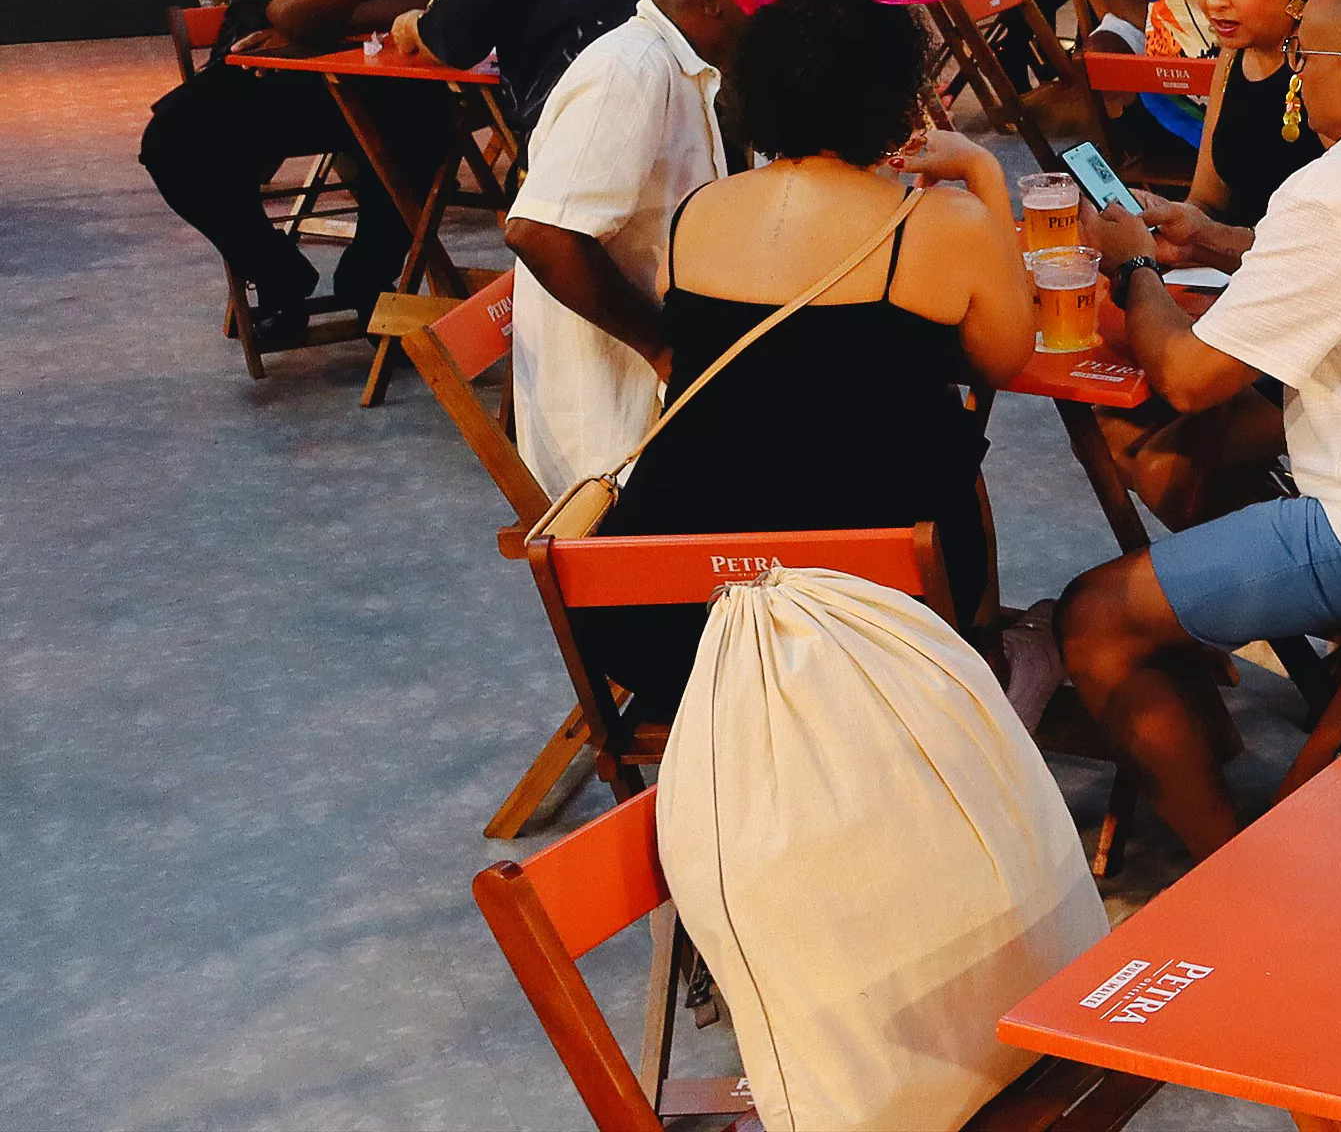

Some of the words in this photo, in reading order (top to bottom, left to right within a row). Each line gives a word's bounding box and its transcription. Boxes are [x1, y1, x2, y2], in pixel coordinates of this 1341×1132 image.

[1155, 67, 1191, 80] PETRA
[709, 555, 785, 573] PETRA
[1114, 961, 1144, 982] PURO
[1085, 980, 1120, 1005] MALTE
[1108, 960, 1216, 1024] PETRA
